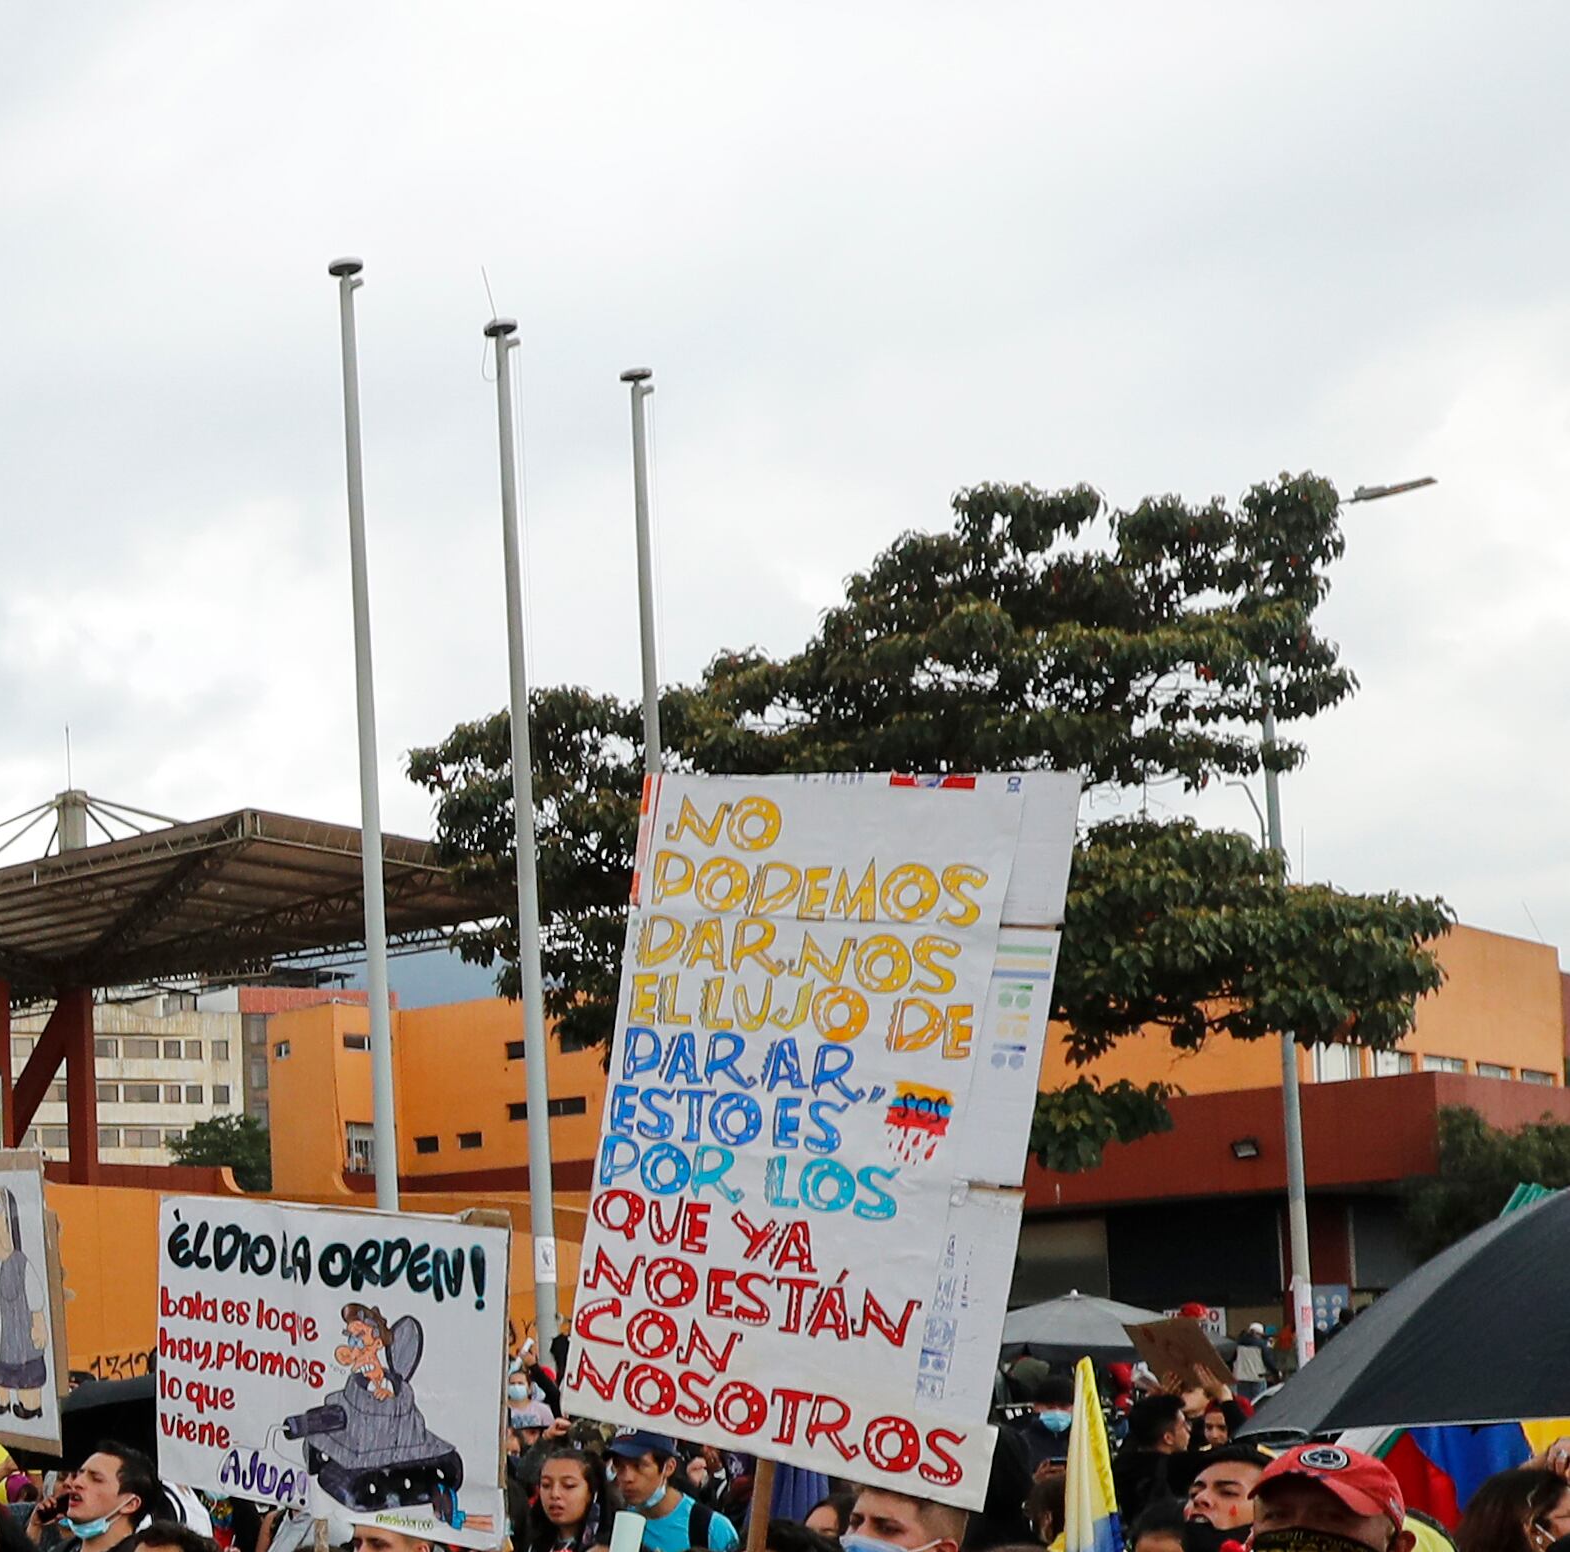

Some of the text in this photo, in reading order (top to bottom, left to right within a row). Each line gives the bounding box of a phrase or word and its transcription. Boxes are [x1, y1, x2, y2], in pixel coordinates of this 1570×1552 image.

[666, 794, 782, 852] NO
[651, 850, 990, 928] PODEMOS
[886, 995, 973, 1061] DE
[897, 1093, 948, 1123] SOS
[599, 1134, 901, 1222] POR LOS
[281, 1230, 311, 1286] LA
[592, 1188, 818, 1274] QUE YA
[221, 1299, 251, 1325] es
[575, 1296, 743, 1373] CON
[159, 1369, 236, 1416] lo que
[566, 1347, 967, 1488] NOSOTROS
[160, 1413, 231, 1449] viene
